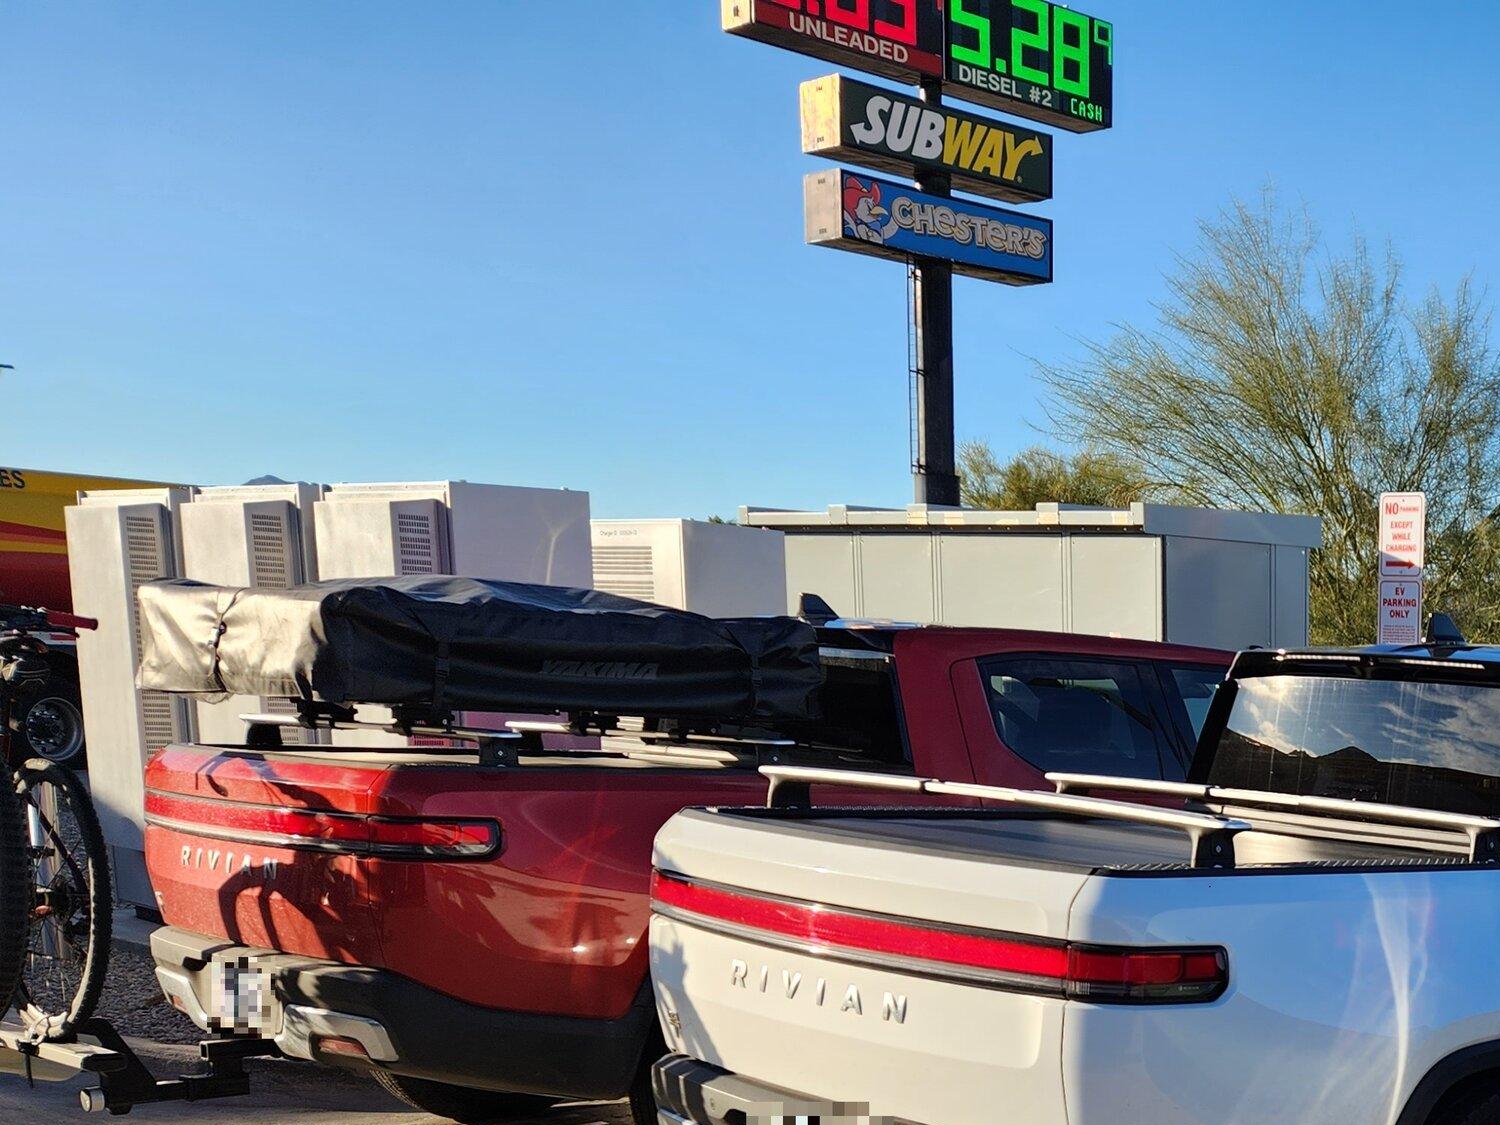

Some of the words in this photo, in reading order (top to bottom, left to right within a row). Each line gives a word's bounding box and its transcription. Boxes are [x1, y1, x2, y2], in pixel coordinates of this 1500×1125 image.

[788, 11, 909, 64] UNLEADED
[958, 64, 1022, 99] DIESEL
[1029, 86, 1052, 107] #2
[1070, 98, 1103, 122] CASH
[850, 95, 1044, 182] SUBWAY
[1385, 503, 1399, 515] NO
[1390, 521, 1413, 529] EXCEPT
[1392, 532, 1411, 540] WHILE
[1385, 544, 1417, 552] CHARGING
[1395, 586, 1405, 596] EV
[1382, 598, 1417, 607] PARKING
[1389, 610, 1410, 619] ONLY
[181, 845, 279, 881] RIVIAN
[730, 958, 908, 1025] RIVIAN
